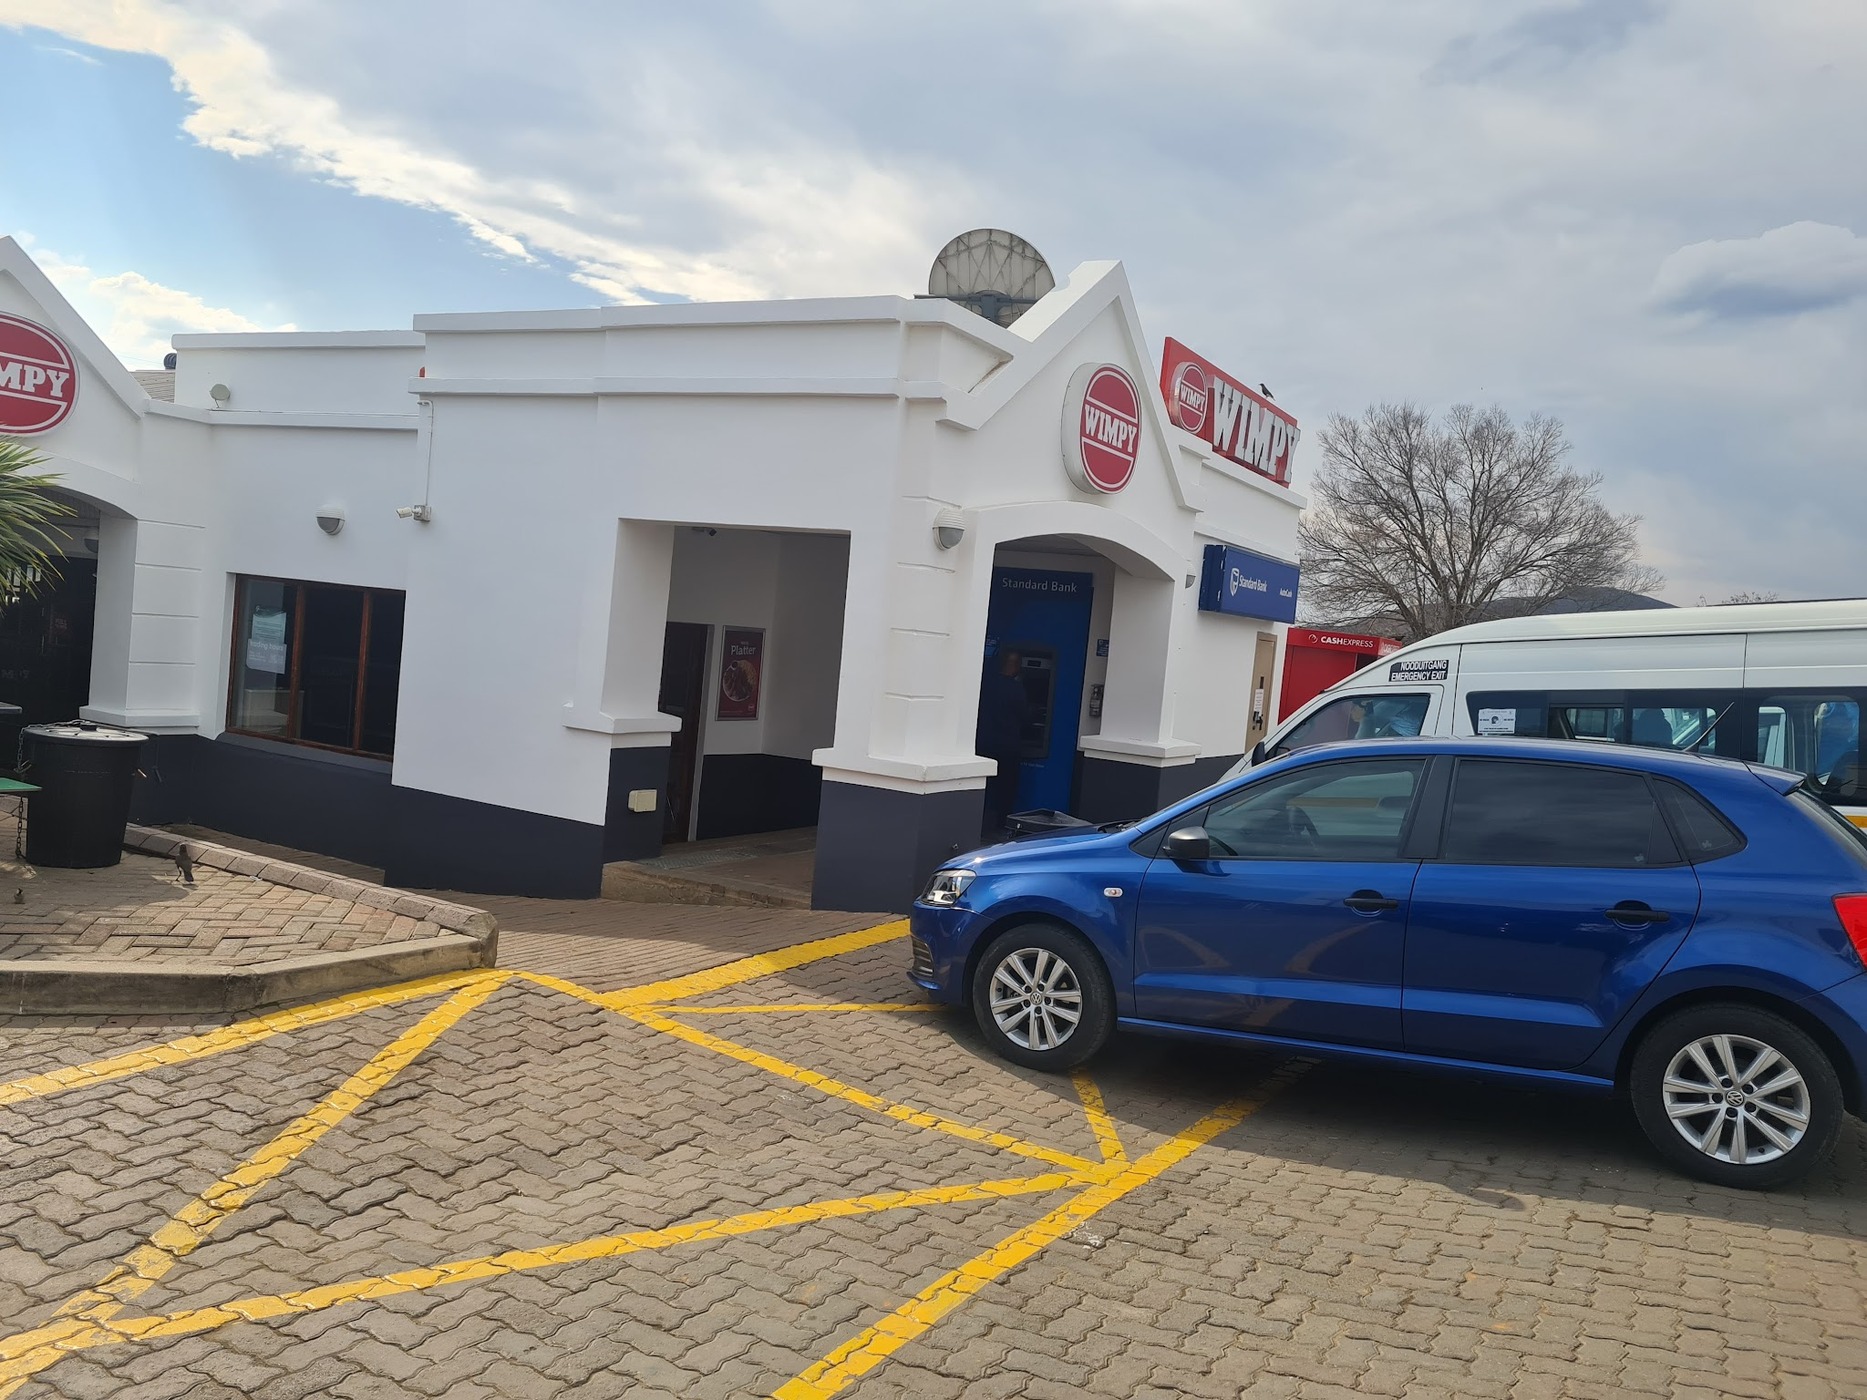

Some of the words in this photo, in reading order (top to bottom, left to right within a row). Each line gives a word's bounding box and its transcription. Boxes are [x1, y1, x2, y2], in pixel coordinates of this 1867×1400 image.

[1181, 384, 1205, 411] WIMPY
[1085, 403, 1138, 453] WIMPY
[1213, 376, 1301, 484] WIMPY
[1002, 577, 1048, 591] Standard
[1051, 581, 1078, 593] Bank
[1239, 575, 1258, 590] Standard
[1257, 579, 1268, 593] Bank
[730, 645, 757, 656] Platter
[1400, 660, 1447, 671] NOODUITGANG
[1391, 671, 1431, 681] EMERGENCY
[1431, 670, 1447, 680] EXIT
